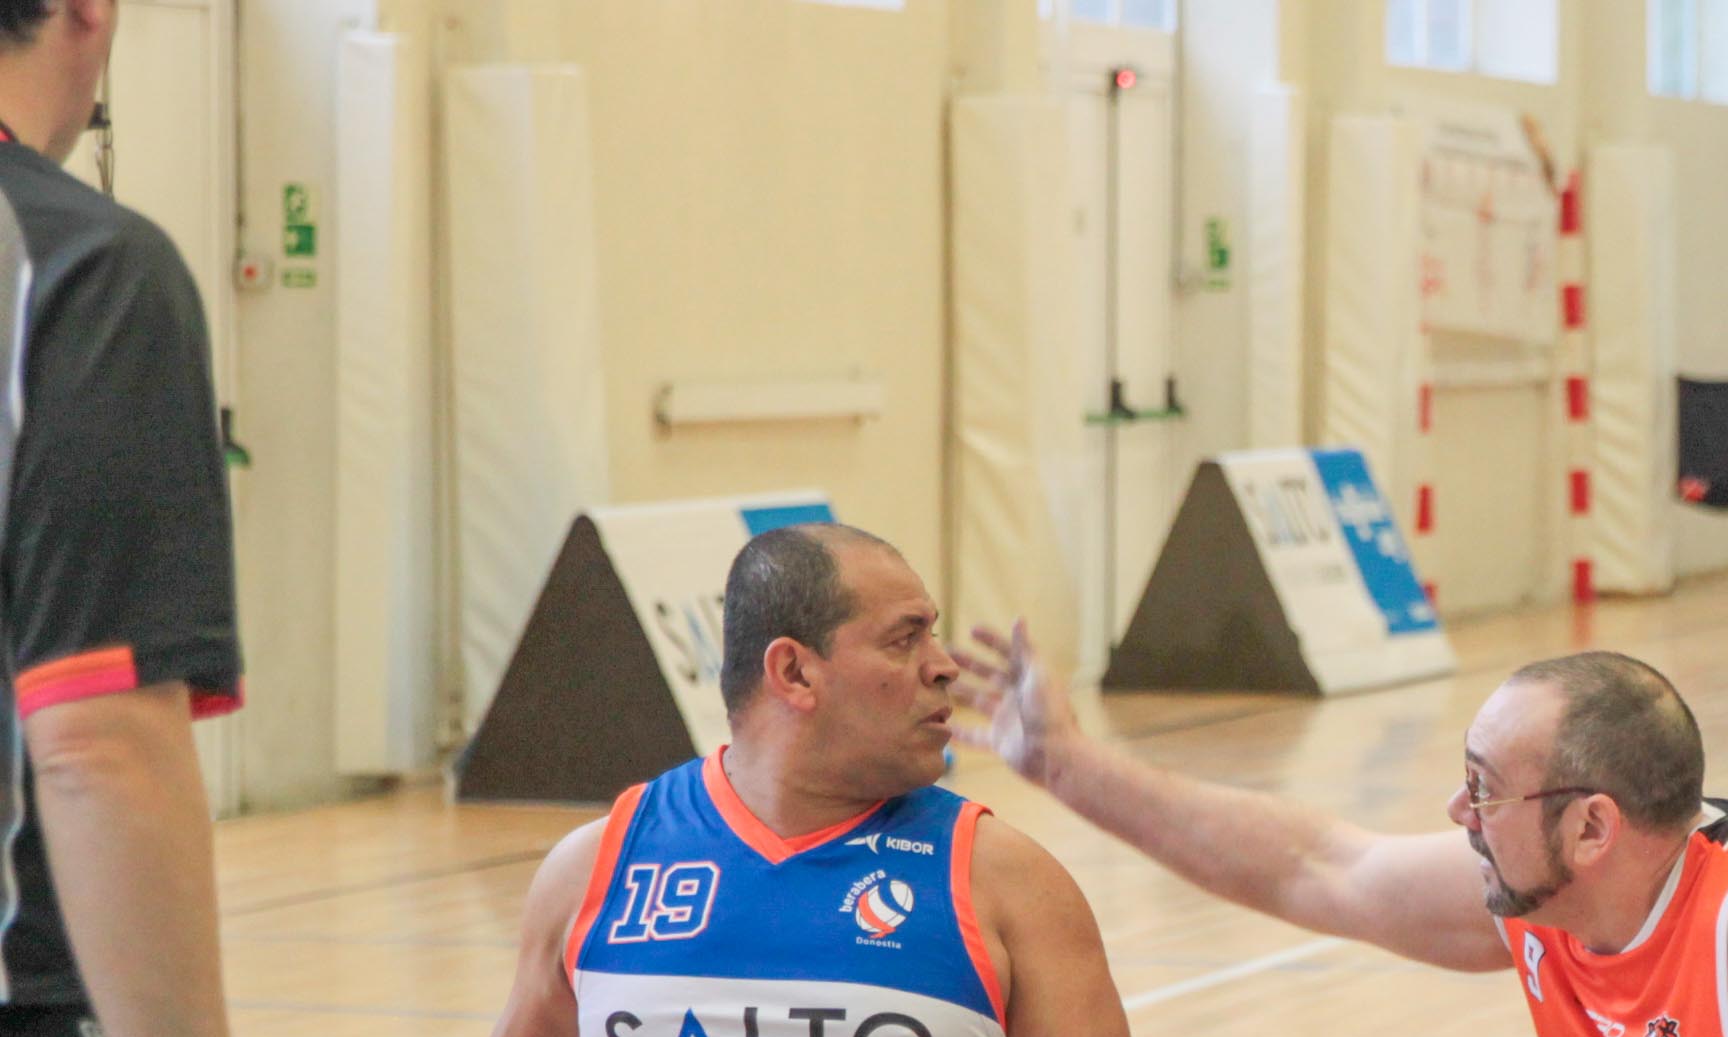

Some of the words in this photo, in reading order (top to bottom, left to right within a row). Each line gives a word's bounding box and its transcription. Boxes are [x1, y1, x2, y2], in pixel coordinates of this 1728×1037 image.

[885, 836, 935, 856] KIBOR
[607, 860, 721, 945] 19
[837, 868, 887, 912] berabera
